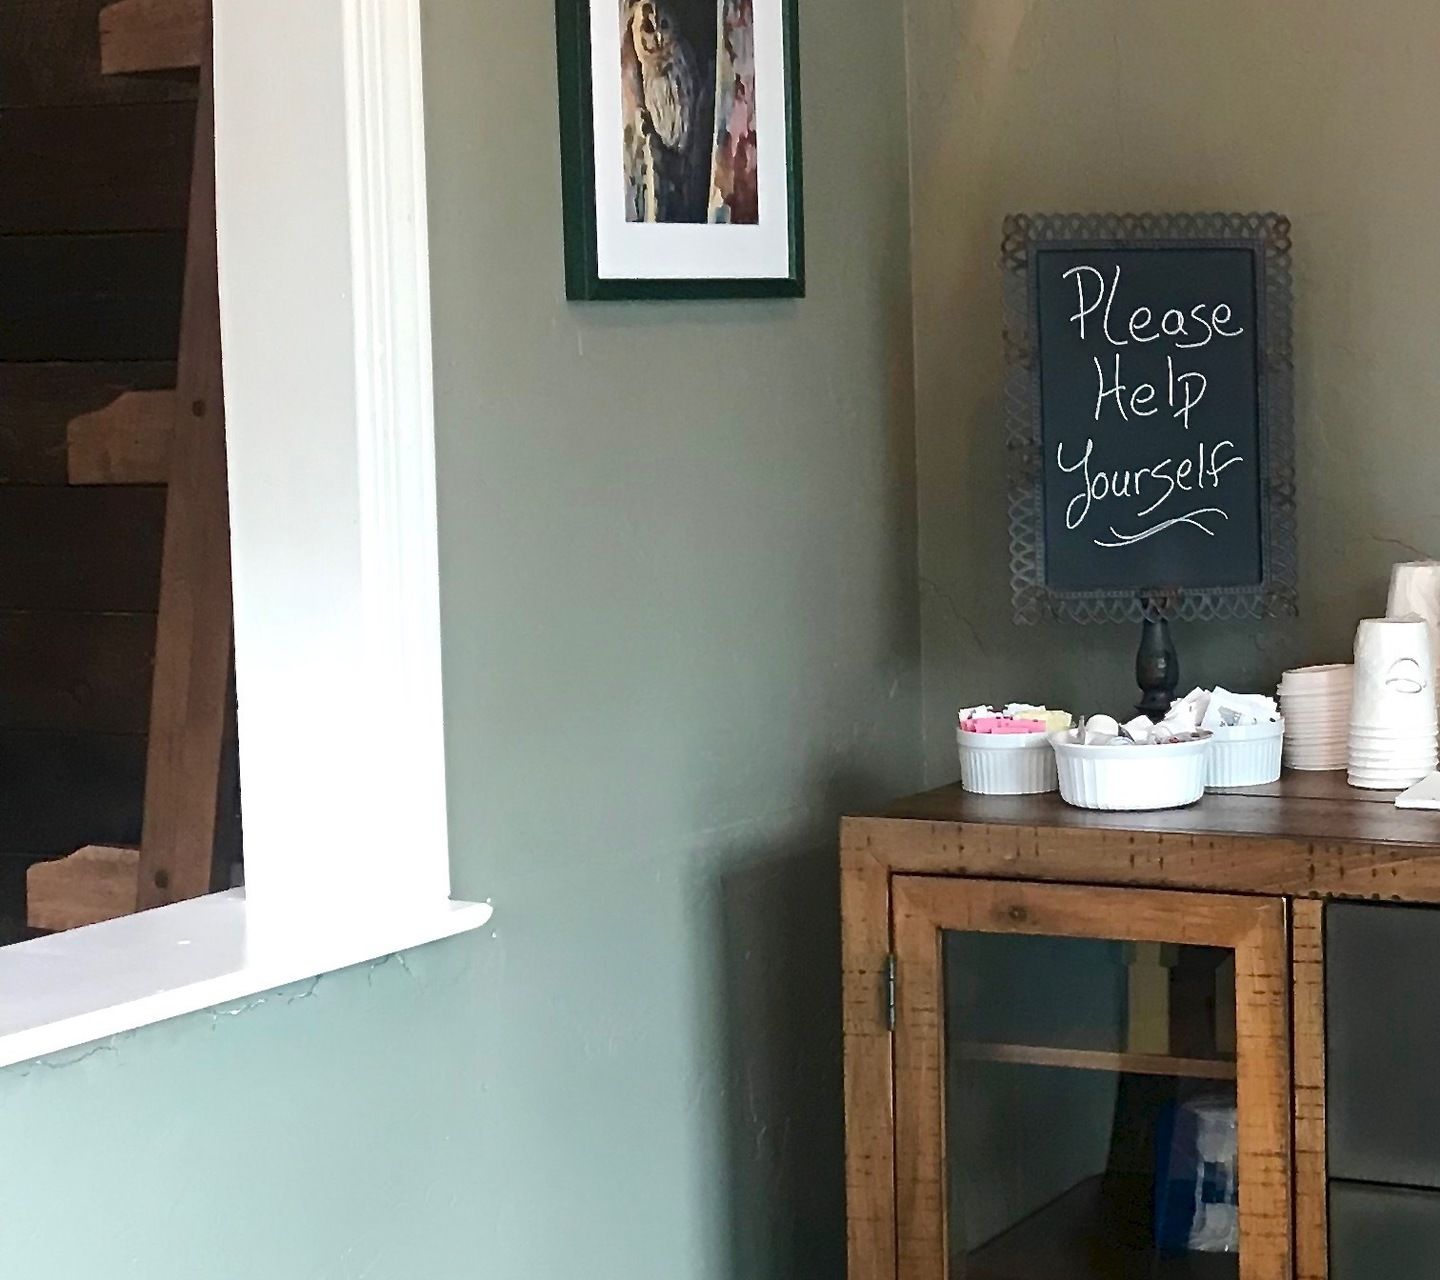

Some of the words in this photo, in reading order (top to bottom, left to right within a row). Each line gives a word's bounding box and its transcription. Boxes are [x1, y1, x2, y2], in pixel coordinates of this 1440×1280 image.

[1062, 265, 1244, 348] Please
[1093, 352, 1208, 430] Help
[1056, 437, 1244, 530] Yourself
